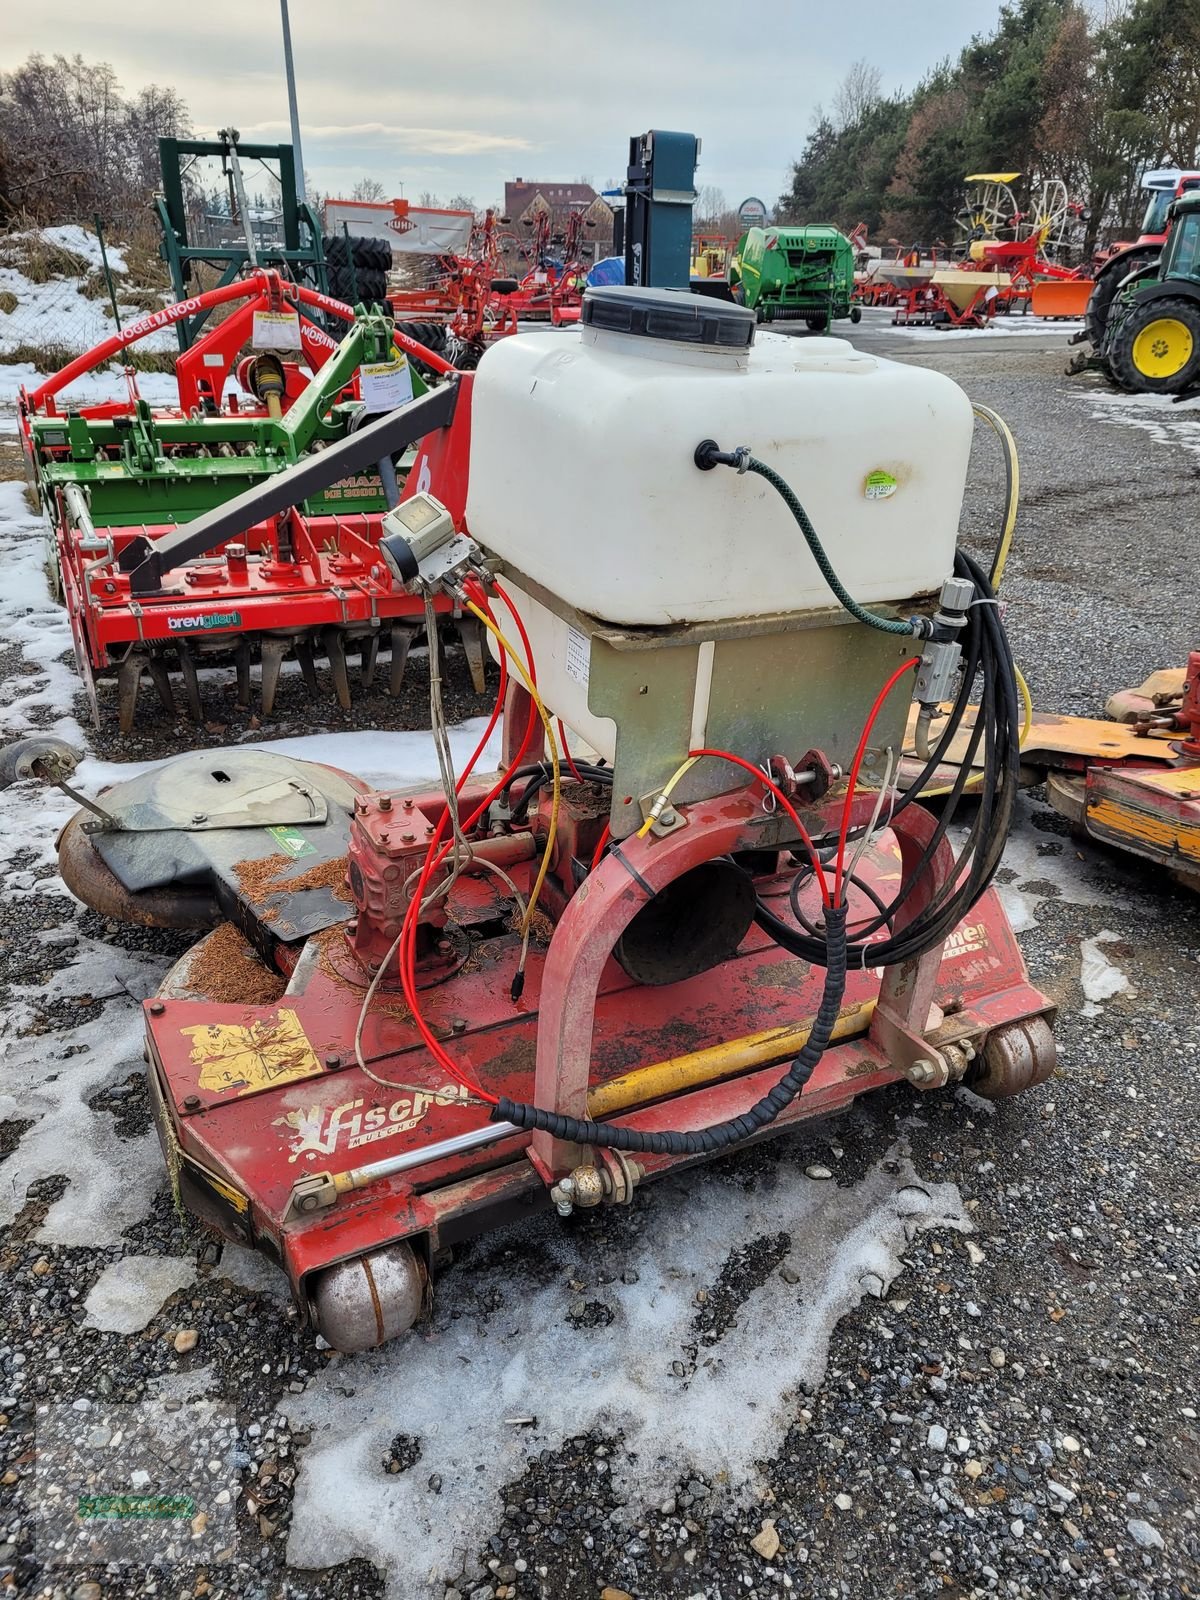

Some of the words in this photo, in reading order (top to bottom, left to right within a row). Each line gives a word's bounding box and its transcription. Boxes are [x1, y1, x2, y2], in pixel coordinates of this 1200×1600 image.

[388, 220, 415, 230] KUHN
[116, 317, 157, 341] VOGEL
[167, 297, 202, 319] NOOT
[401, 335, 417, 348] 300
